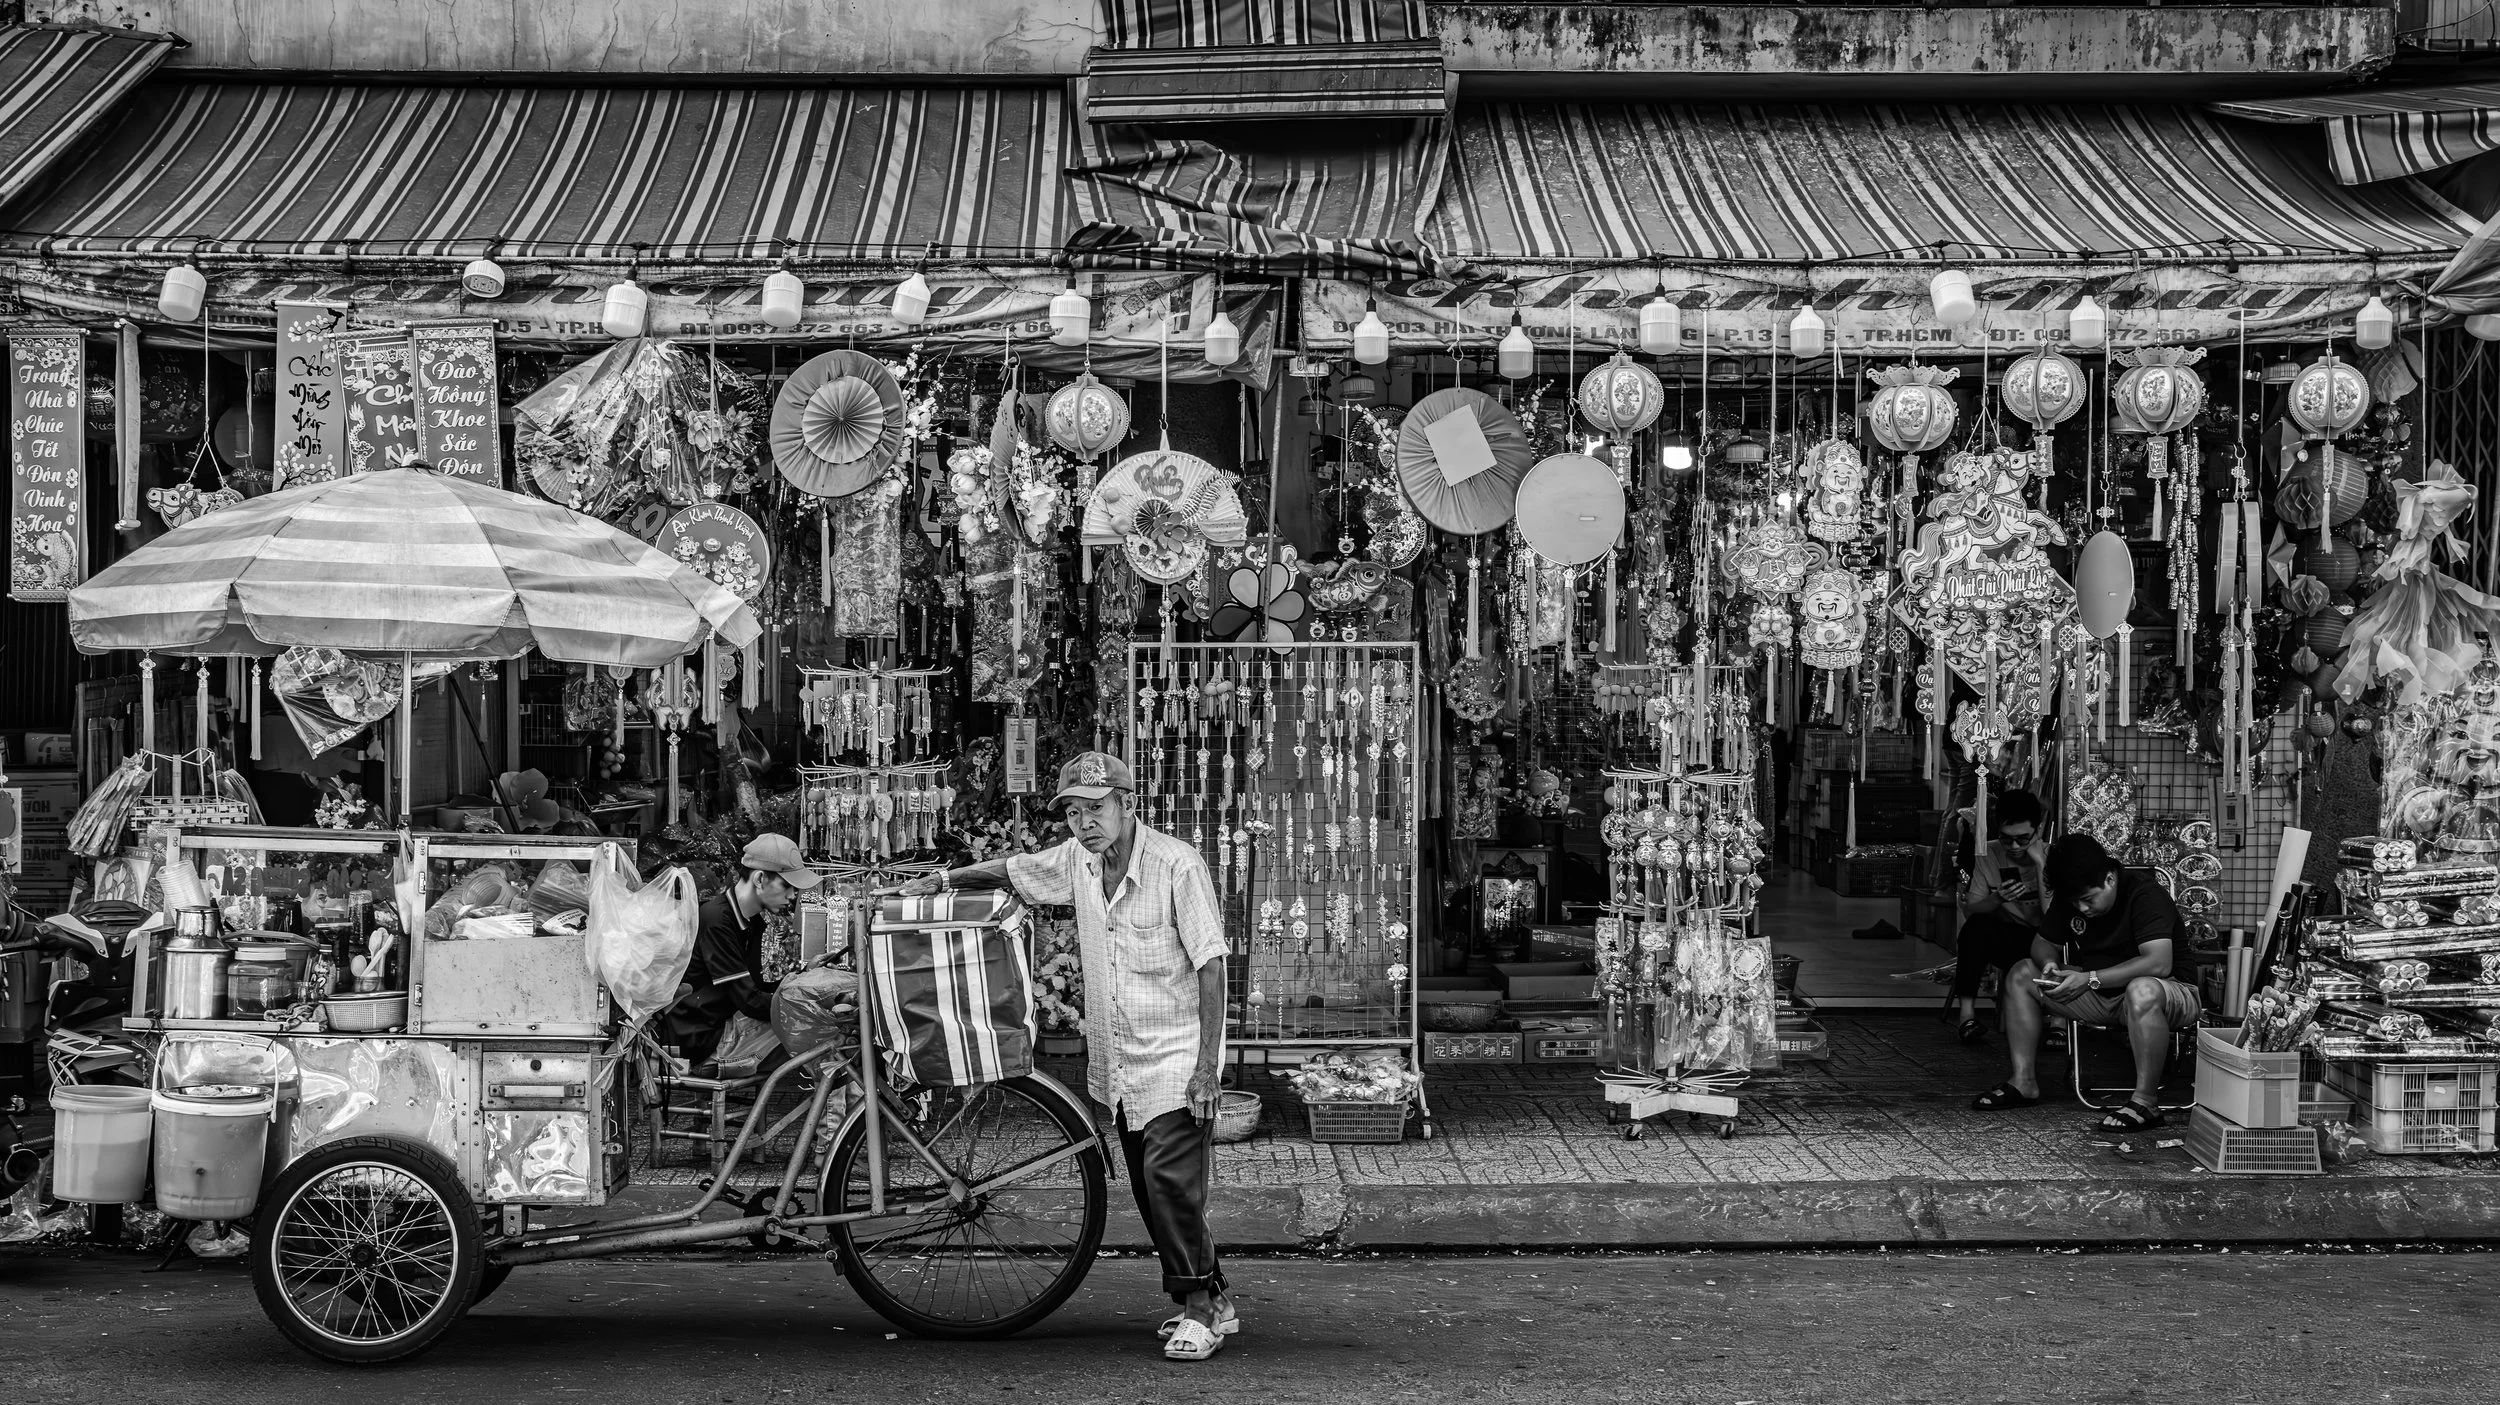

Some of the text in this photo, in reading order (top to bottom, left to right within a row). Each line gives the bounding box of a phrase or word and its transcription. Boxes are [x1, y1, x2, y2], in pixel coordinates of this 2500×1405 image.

[556, 321, 604, 334] TP.H
[840, 324, 883, 334] 663
[1383, 322, 1426, 333] 203
[1591, 325, 1637, 339] LÃN
[1724, 329, 1772, 341] P.13
[1862, 329, 1952, 341] TP.HCM
[1990, 329, 2025, 341] ĐT:
[2156, 328, 2200, 341] 663
[18, 364, 72, 387] Trong
[432, 361, 478, 380] Đào
[25, 390, 63, 408] Nhà
[427, 385, 487, 406] Hồng
[25, 414, 64, 433] Chúc
[429, 409, 487, 428] Khoe
[31, 439, 59, 458] Tết
[440, 433, 477, 452] Sắc
[26, 465, 62, 483] Đón
[437, 457, 484, 475] Đón
[23, 489, 66, 508] Vinh
[27, 514, 62, 532] Hoa
[1948, 568, 2048, 602] Phát Tài Phát Lộc
[1919, 673, 1934, 685] Vạ
[2025, 673, 2040, 683] Nh
